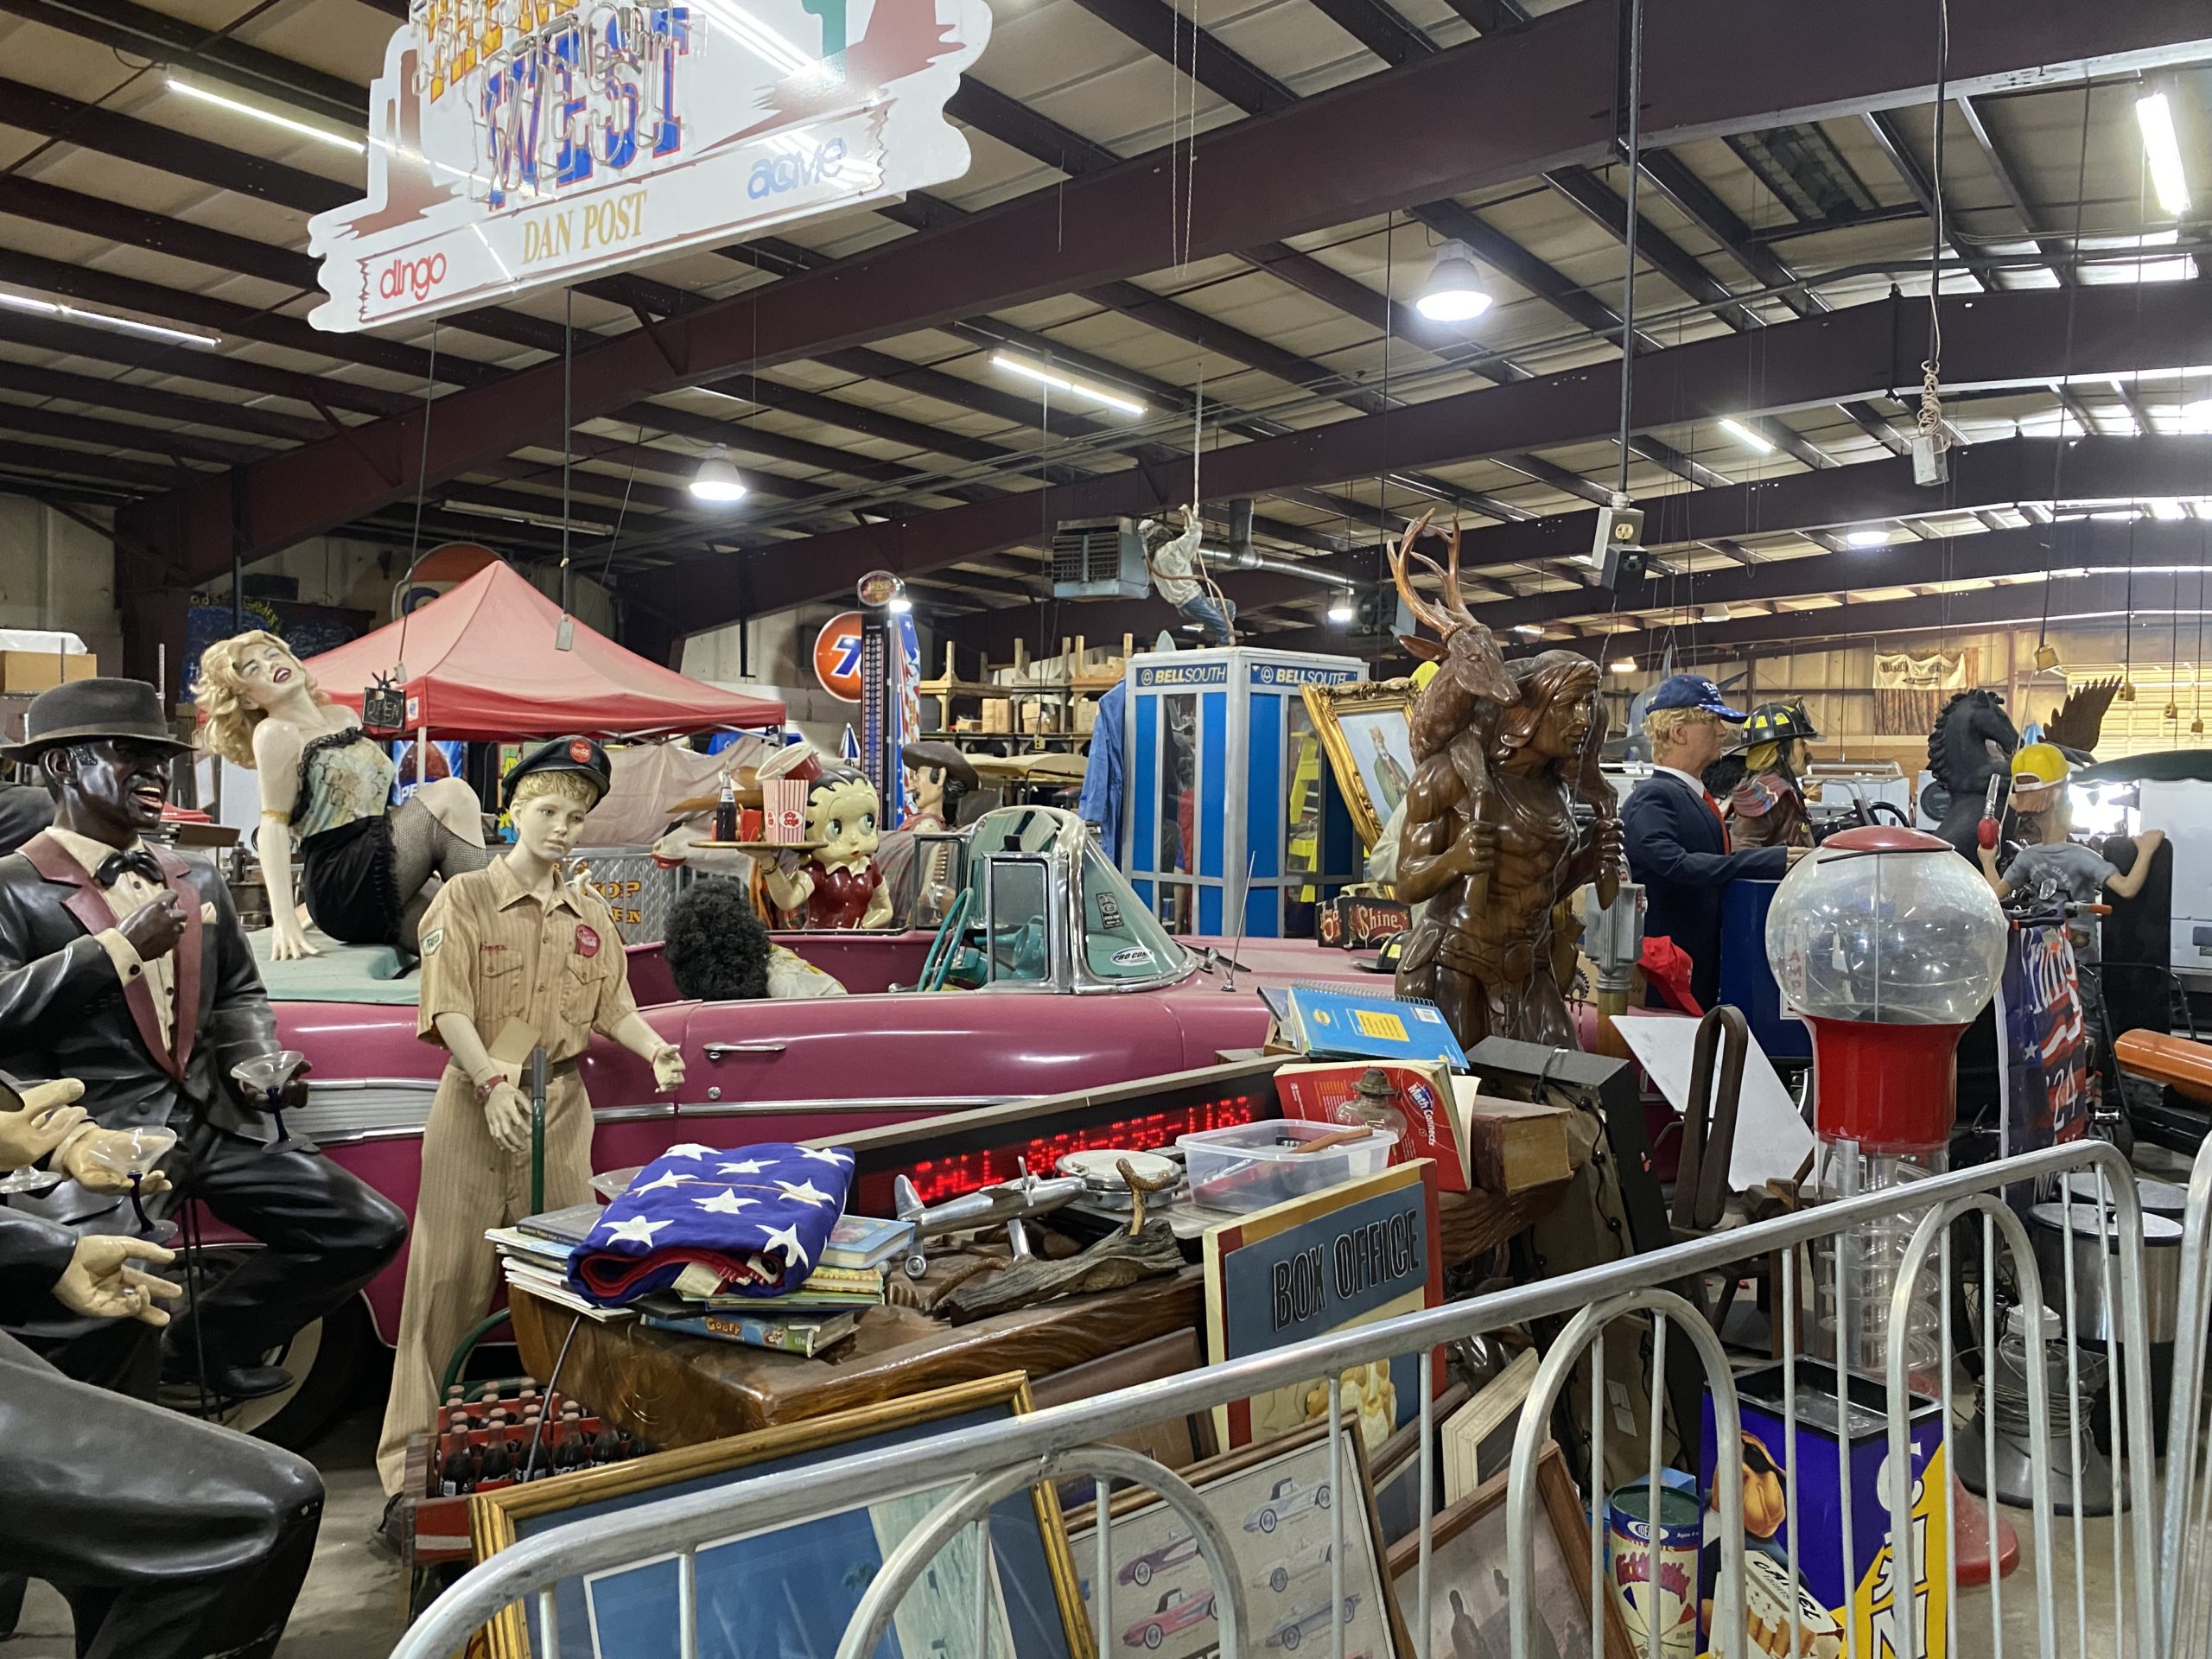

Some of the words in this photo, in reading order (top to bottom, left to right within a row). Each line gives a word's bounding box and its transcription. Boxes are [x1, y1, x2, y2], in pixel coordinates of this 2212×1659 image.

[481, 7, 690, 211] WEST
[747, 137, 849, 200] acme
[521, 209, 574, 264] DAN
[581, 189, 648, 251] POST
[379, 251, 447, 301] dingo
[828, 634, 861, 679] 7
[1154, 666, 1227, 684] BELLSOUTH
[1275, 668, 1347, 686] BELLSOUTH
[1356, 904, 1403, 949] Shine
[1112, 953, 1130, 962] PRO
[1408, 1083, 1430, 1109] Math
[1423, 1109, 1435, 1147] Connects
[914, 1150, 1006, 1202] CALL
[1274, 1243, 1327, 1332] BOX
[1333, 1210, 1421, 1300] OFFICE
